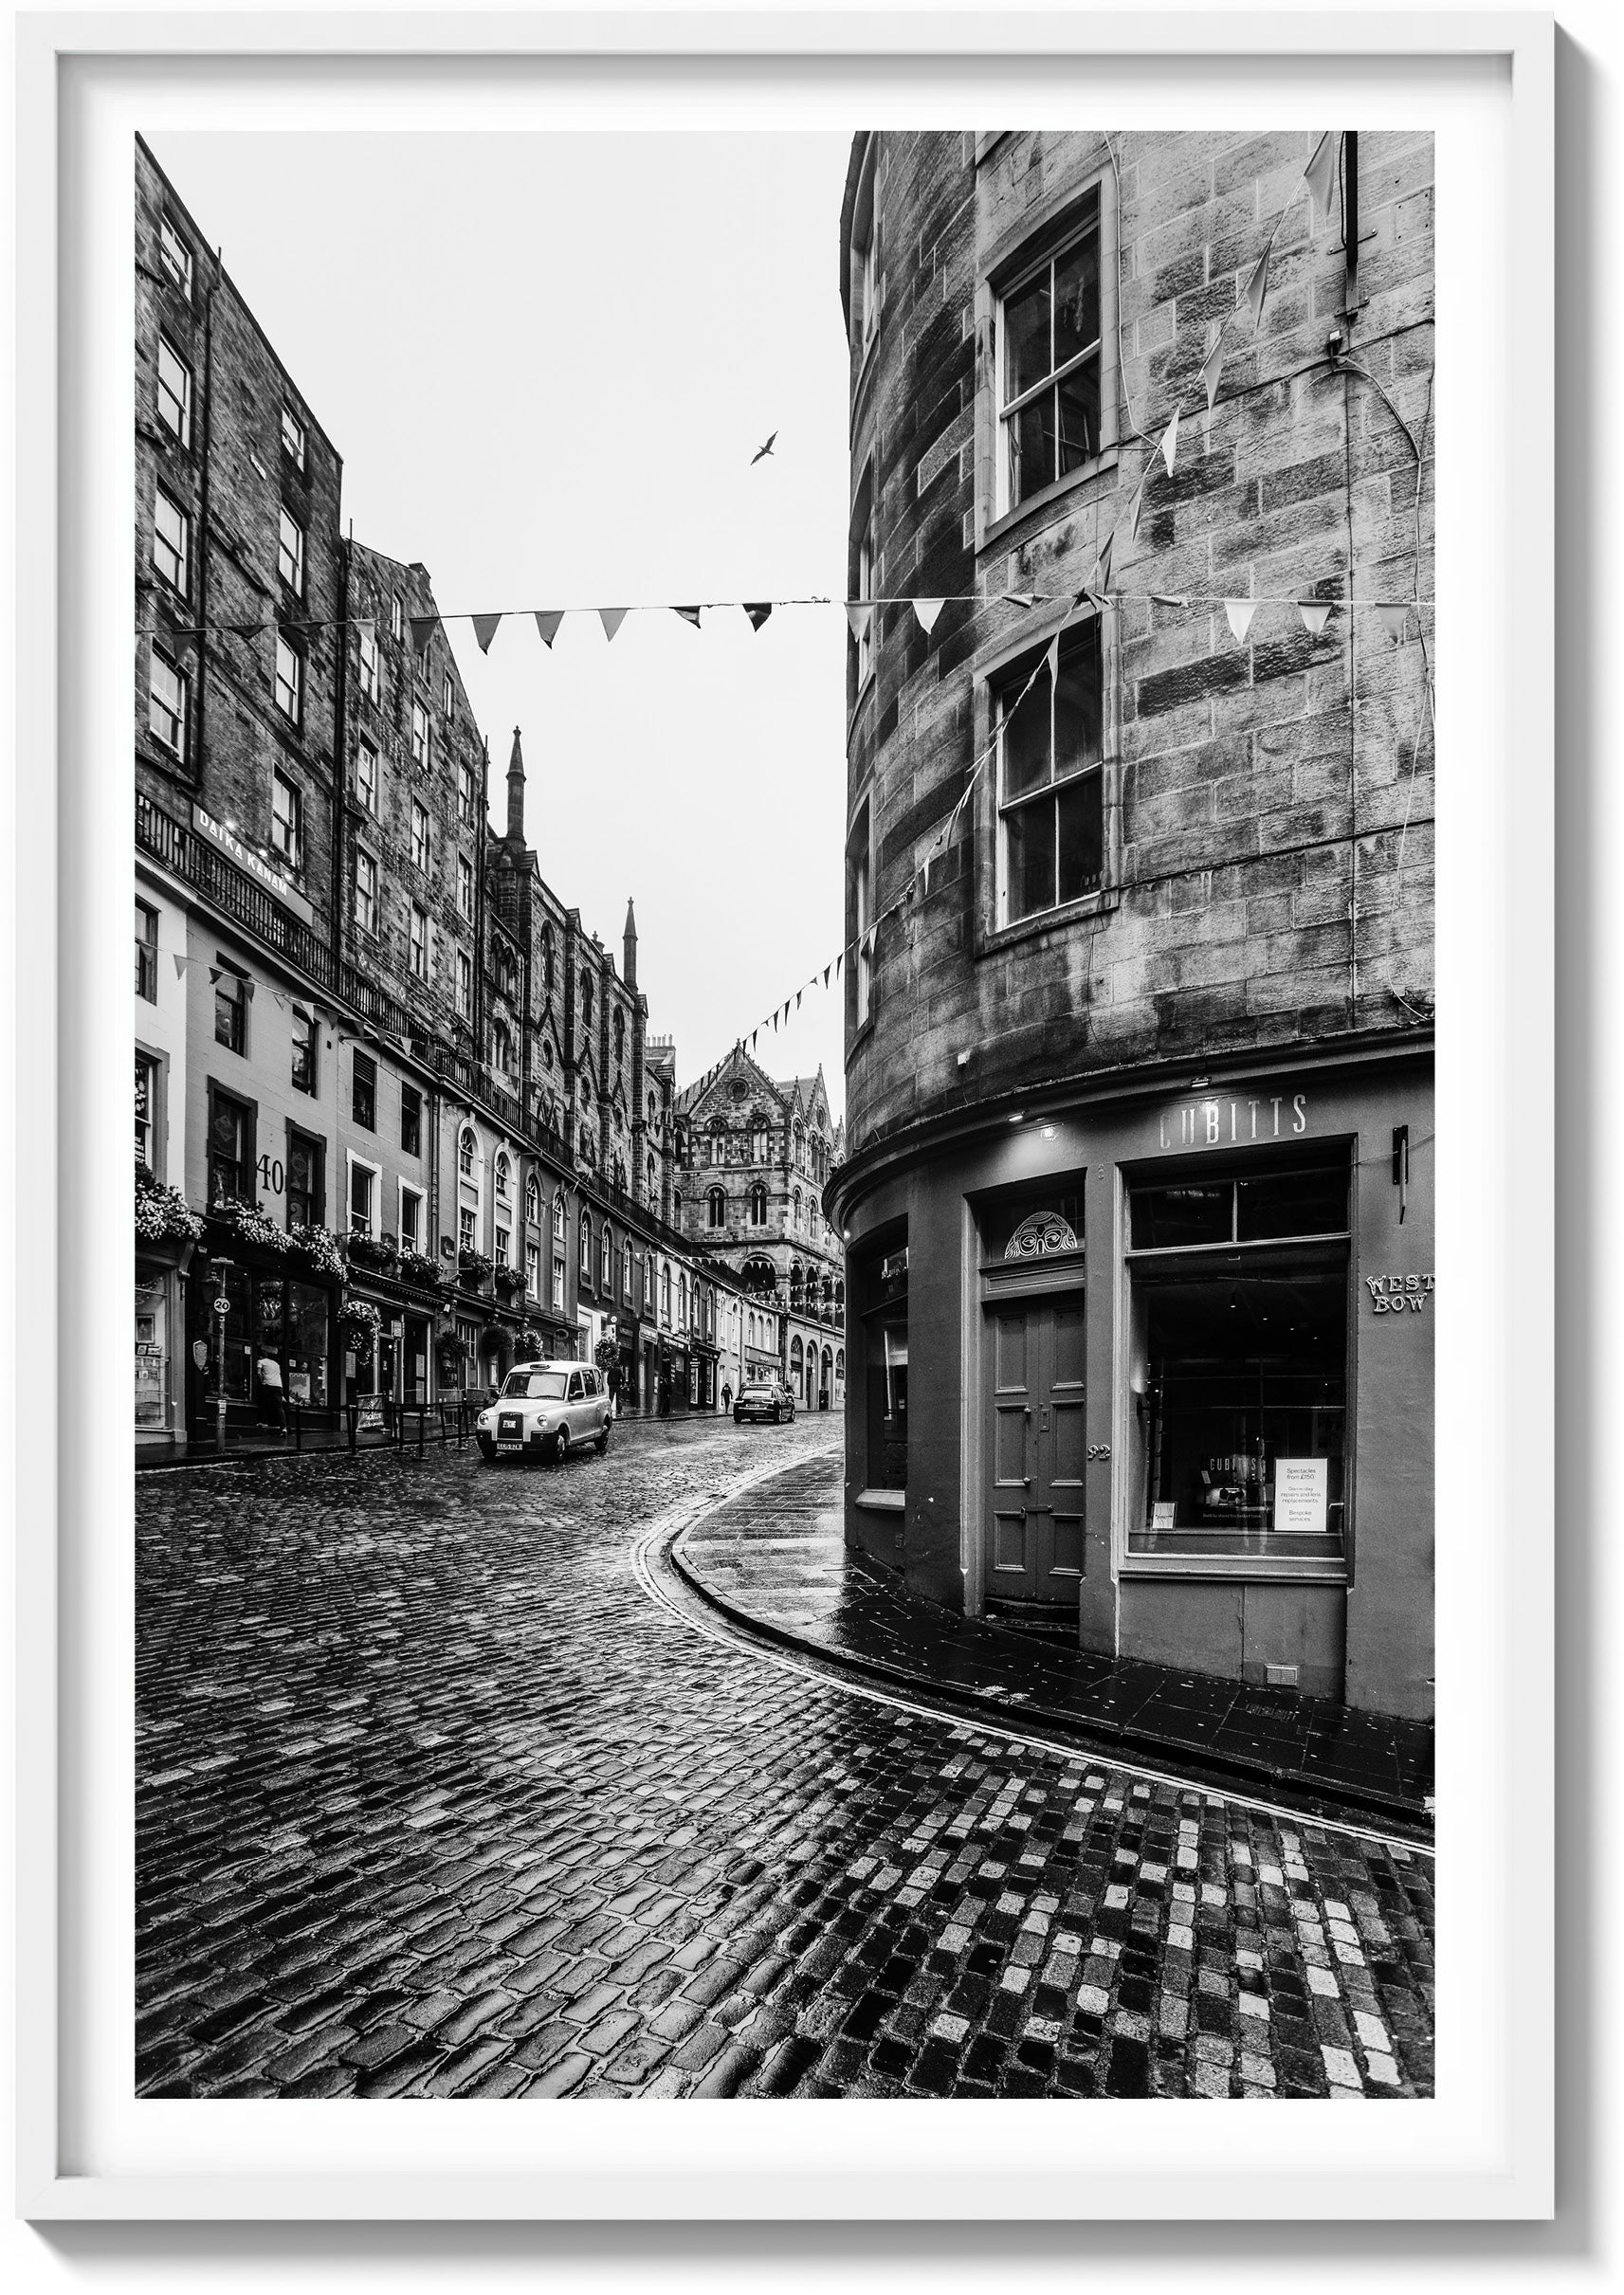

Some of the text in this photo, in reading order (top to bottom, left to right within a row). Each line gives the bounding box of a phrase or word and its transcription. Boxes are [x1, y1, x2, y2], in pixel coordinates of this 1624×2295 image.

[1159, 1094, 1306, 1150] CUBITTS
[257, 1154, 284, 1195] 40
[1365, 1274, 1435, 1296] WEST
[215, 1301, 229, 1311] 20
[1374, 1292, 1428, 1313] BOW
[1087, 1444, 1111, 1460] 92
